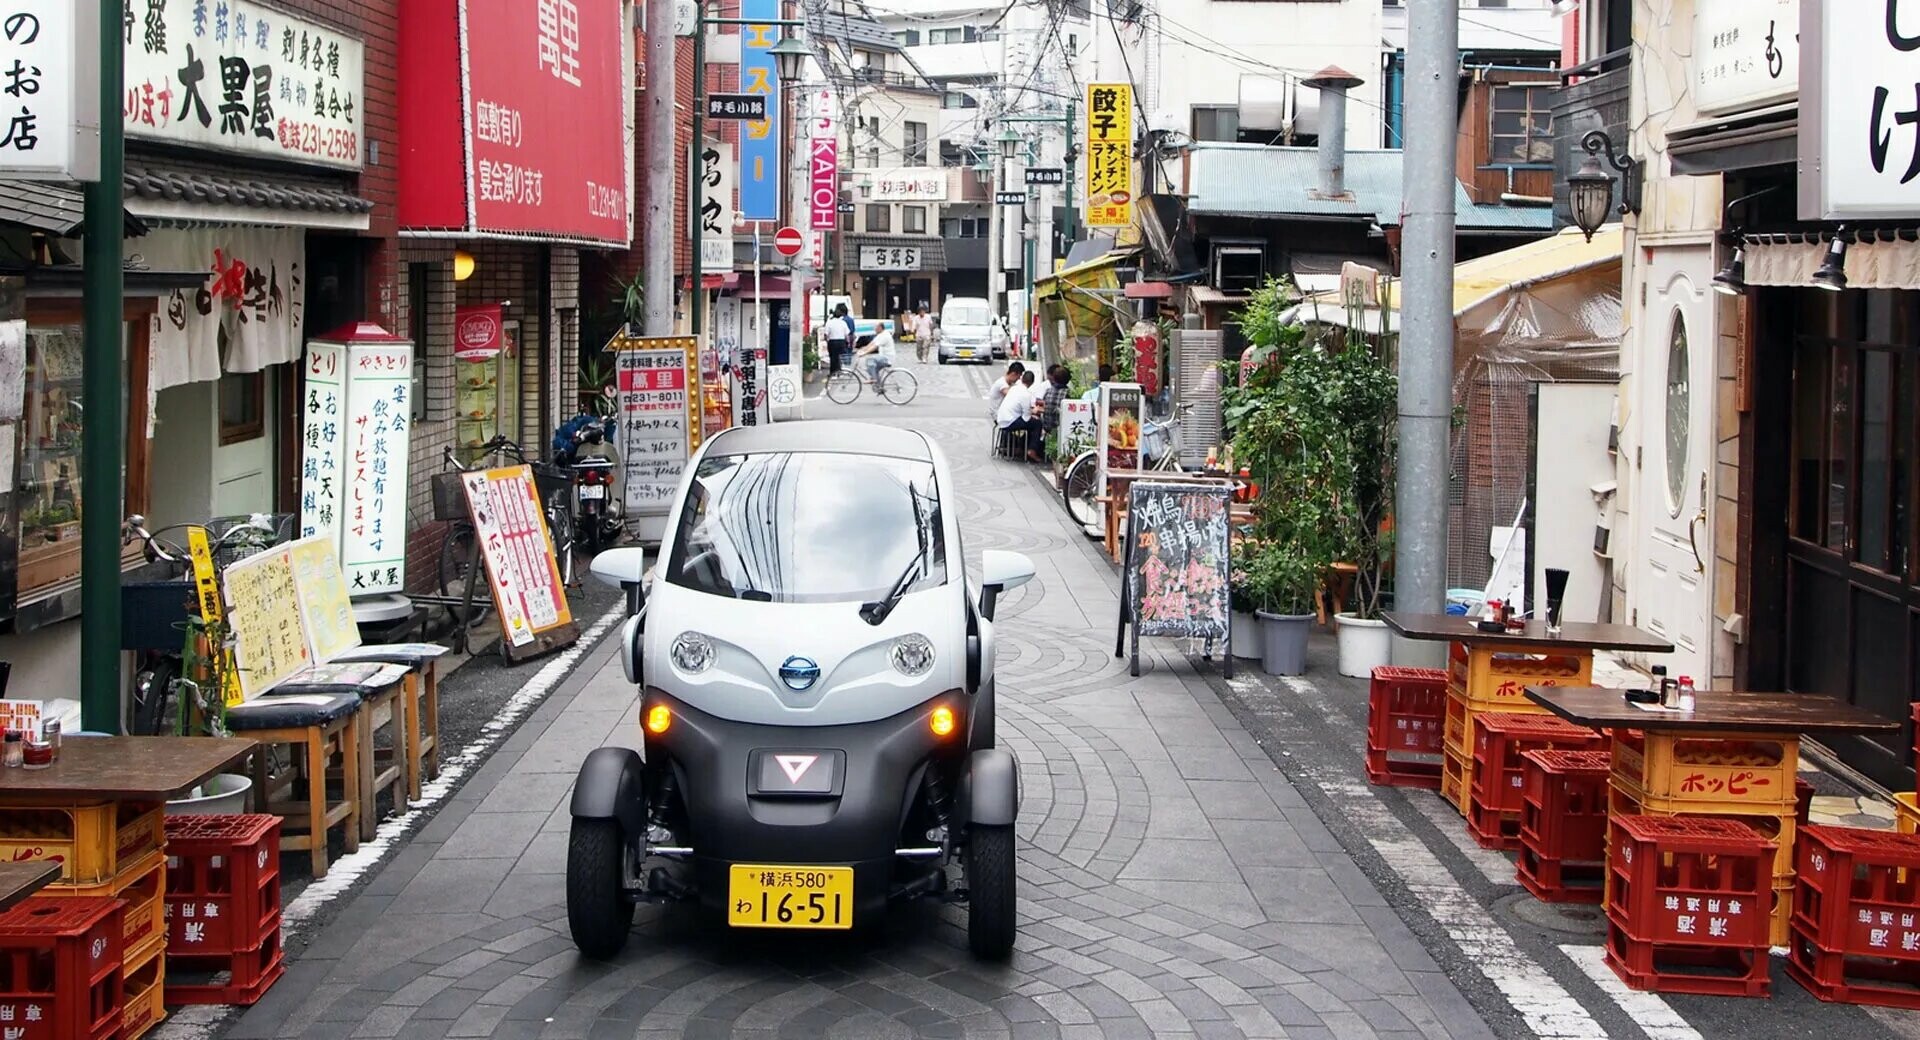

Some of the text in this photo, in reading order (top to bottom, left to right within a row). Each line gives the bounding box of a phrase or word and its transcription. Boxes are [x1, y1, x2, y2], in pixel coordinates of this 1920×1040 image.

[191, 0, 270, 51] 季節料理
[281, 24, 340, 80] 刺身各種
[0, 12, 42, 152] のお店
[123, 76, 174, 129] ります
[177, 43, 275, 141] 大黒屋
[313, 77, 354, 124] 盛合せ
[476, 98, 522, 148] 座敷有り
[1092, 88, 1117, 138] 餃子
[478, 157, 543, 207] 宴会承ります
[813, 139, 834, 227] KATOH
[1091, 143, 1103, 194] ラーメン
[1106, 143, 1118, 190] チンチン
[312, 352, 336, 376] とり
[360, 354, 407, 370] やきとり
[392, 384, 406, 432] 宴会
[631, 391, 683, 402] 231-8011
[352, 415, 368, 537] サービスします
[369, 399, 389, 552] 飲み放題有ります
[352, 567, 399, 589] 大黒屋
[1680, 771, 1771, 795] ホッピー
[736, 892, 841, 924] わ 16-51
[1677, 915, 1728, 937] 清酒
